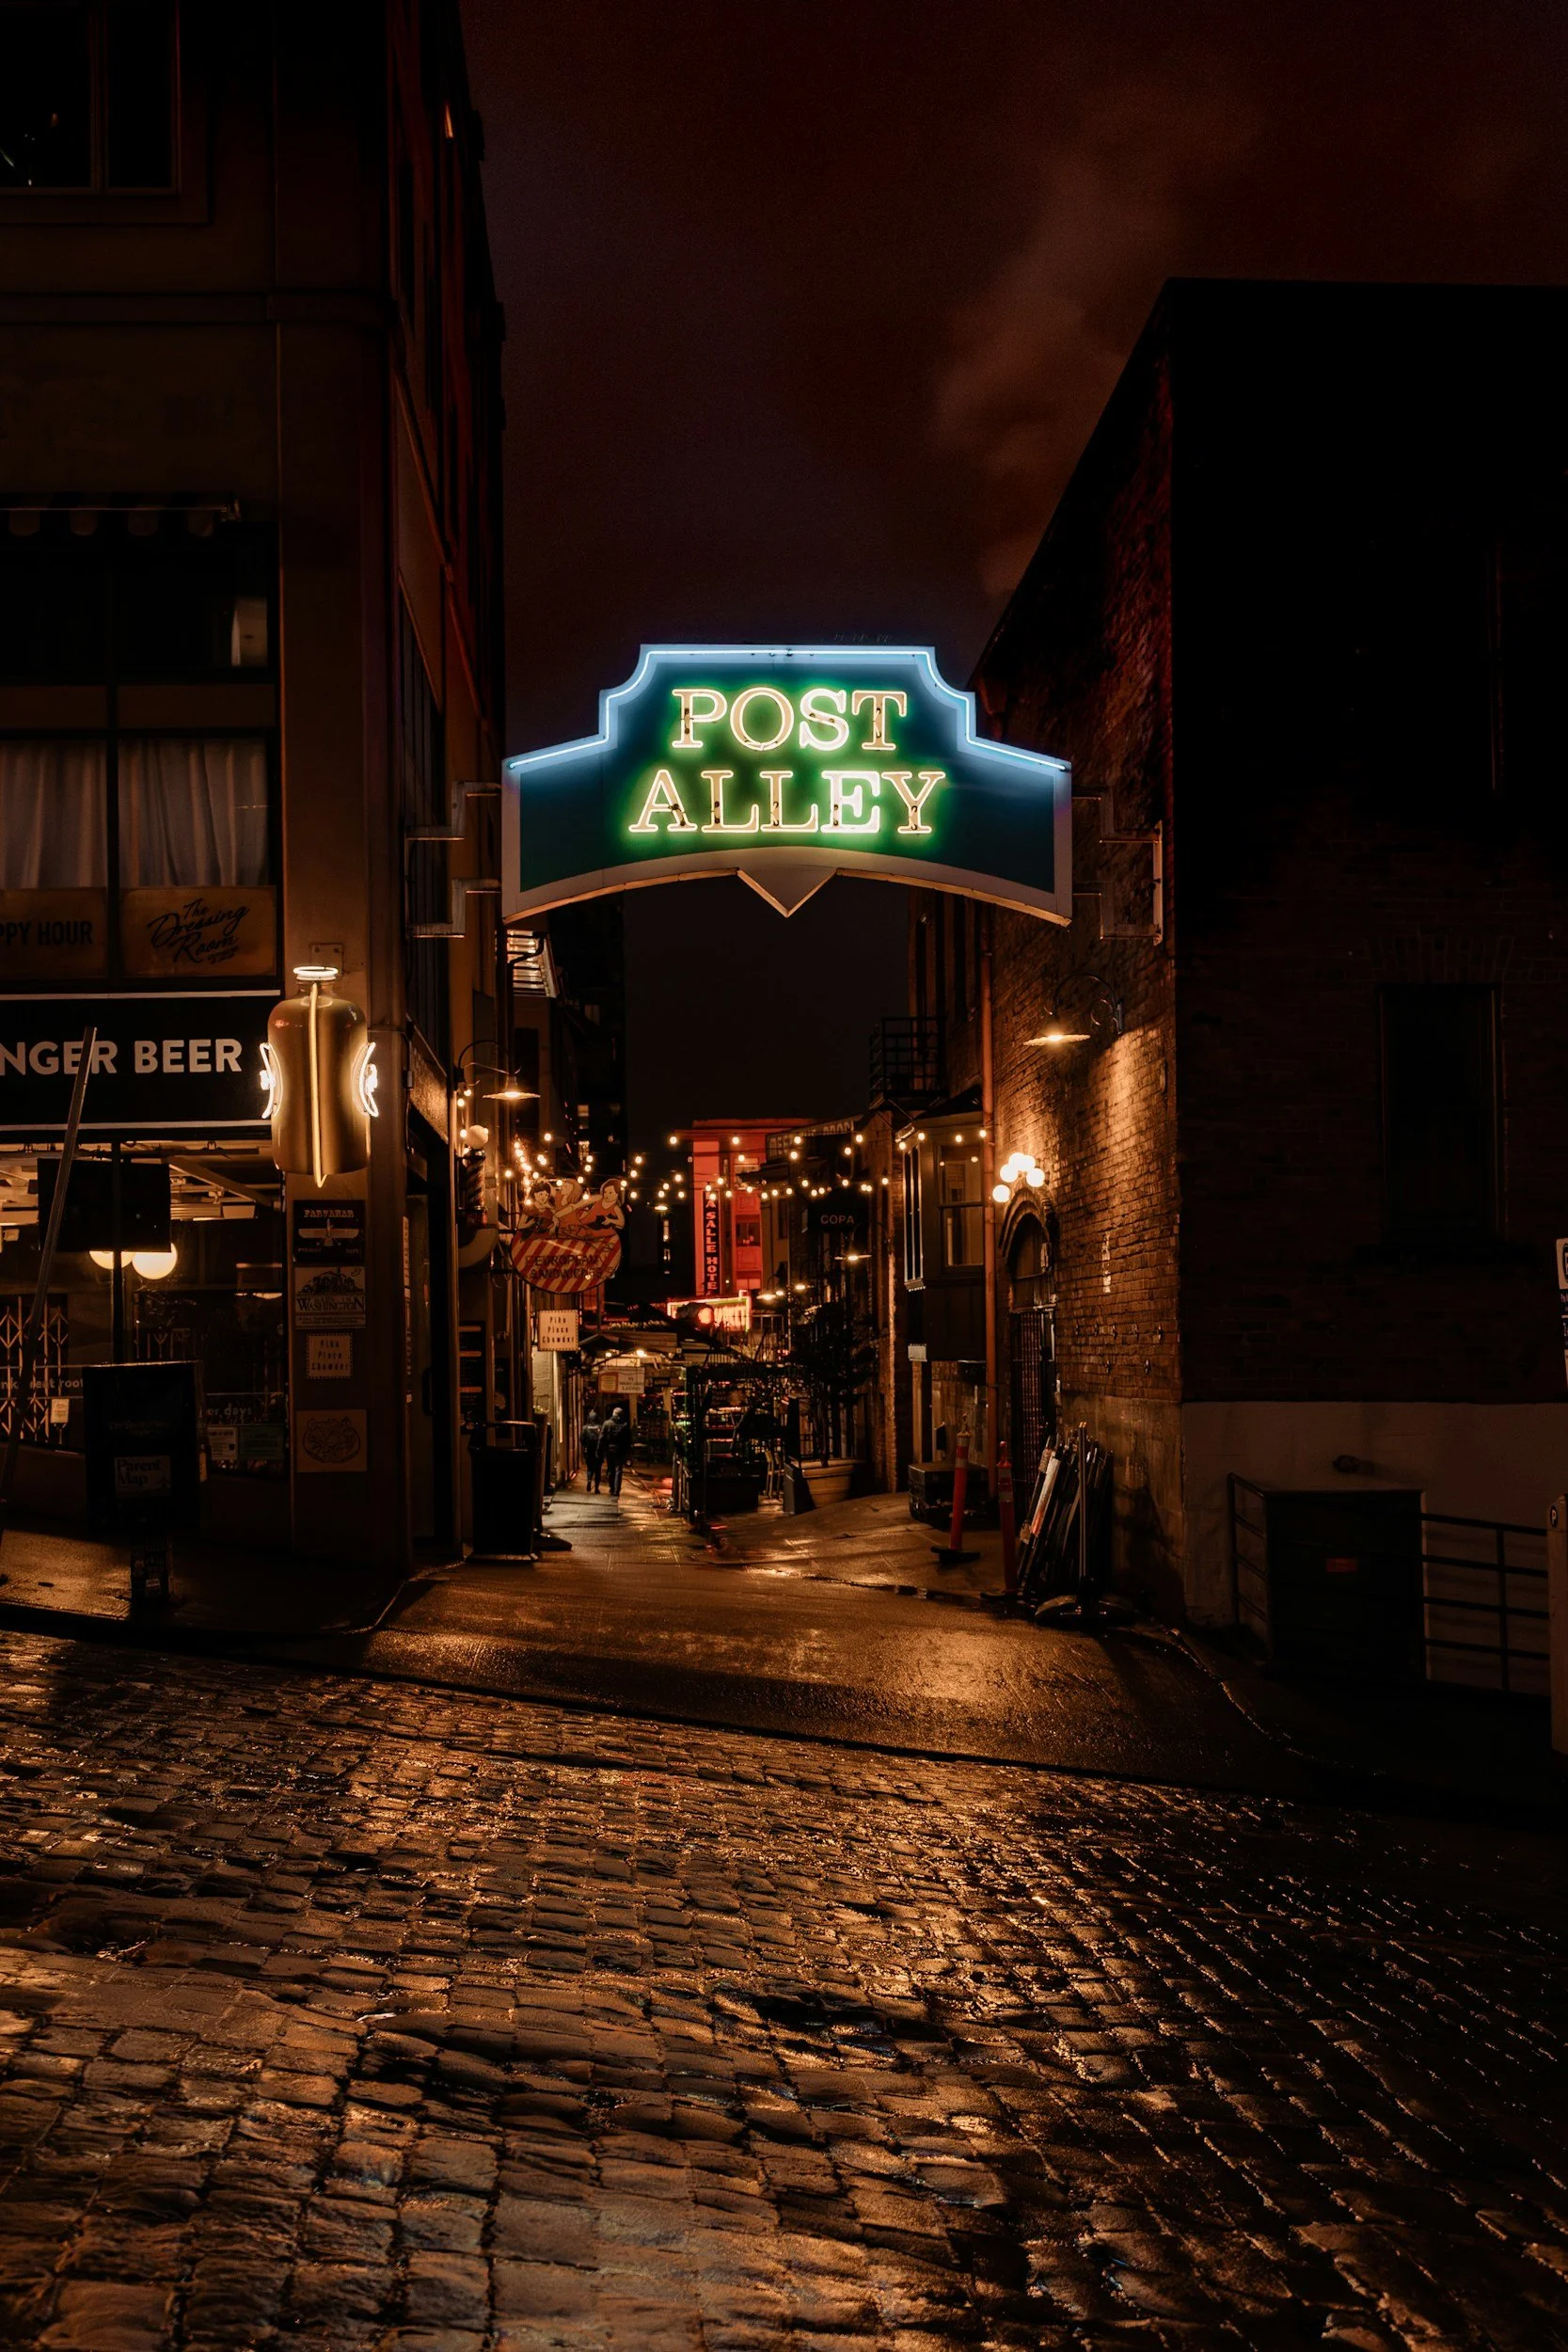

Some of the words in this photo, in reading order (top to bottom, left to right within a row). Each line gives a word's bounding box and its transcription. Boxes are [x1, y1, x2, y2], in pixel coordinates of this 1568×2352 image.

[671, 687, 908, 752] POST
[628, 769, 946, 834] ALLEY
[183, 898, 208, 919] The
[38, 920, 92, 946] HOUR
[147, 906, 250, 948] Dressing
[169, 931, 241, 963] Room
[134, 1038, 243, 1074] BEER
[705, 1211, 717, 1253] SALLE
[819, 1214, 855, 1225] COPA
[118, 1459, 161, 1472] Parent
[119, 1474, 149, 1486] Map
